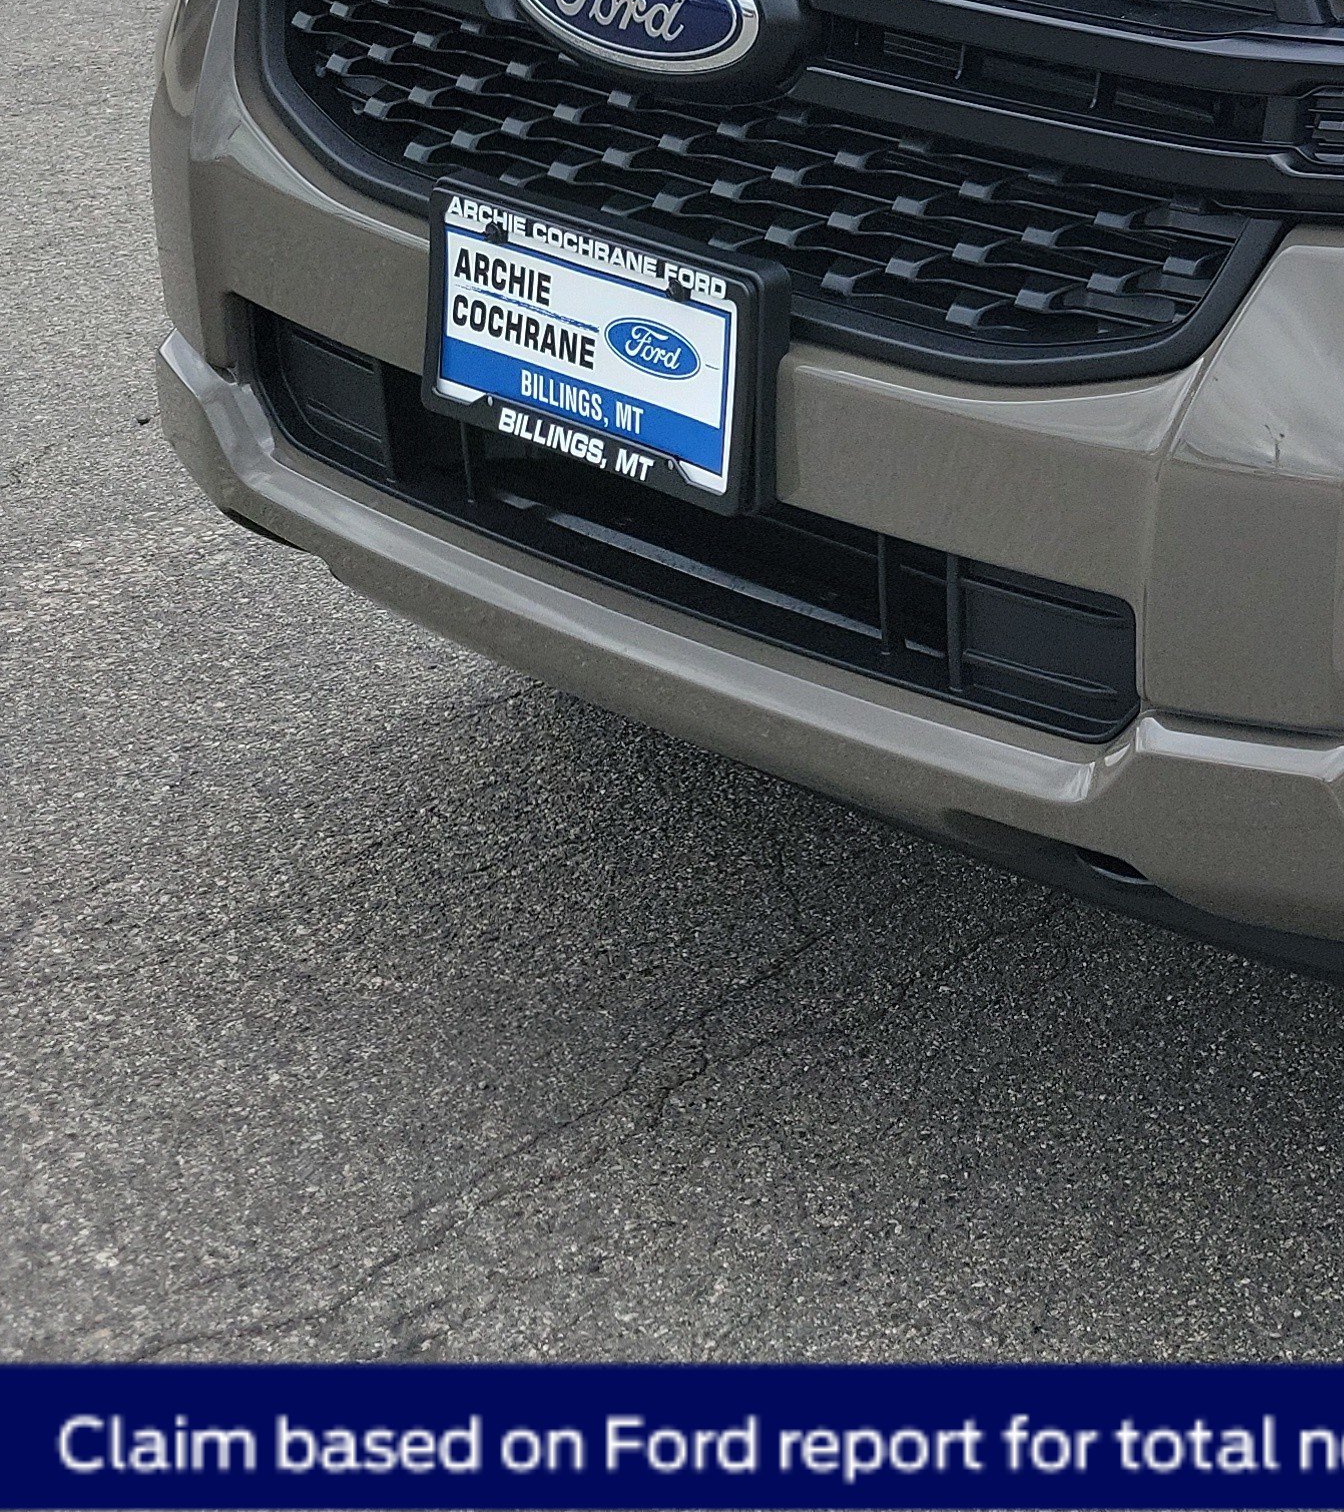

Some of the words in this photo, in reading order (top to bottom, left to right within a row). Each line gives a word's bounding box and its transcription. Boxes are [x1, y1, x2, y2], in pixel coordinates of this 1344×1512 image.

[447, 195, 527, 236] ARCHIE
[532, 223, 658, 281] COCHRANE
[663, 262, 728, 300] FORD
[453, 247, 553, 308] ARCHIE
[452, 294, 597, 371] COCHRANE
[624, 324, 682, 371] Ford
[520, 368, 609, 428] BILLINGS,
[615, 401, 645, 436] MT
[498, 407, 608, 470] BILLINGS,
[615, 448, 656, 482] MT
